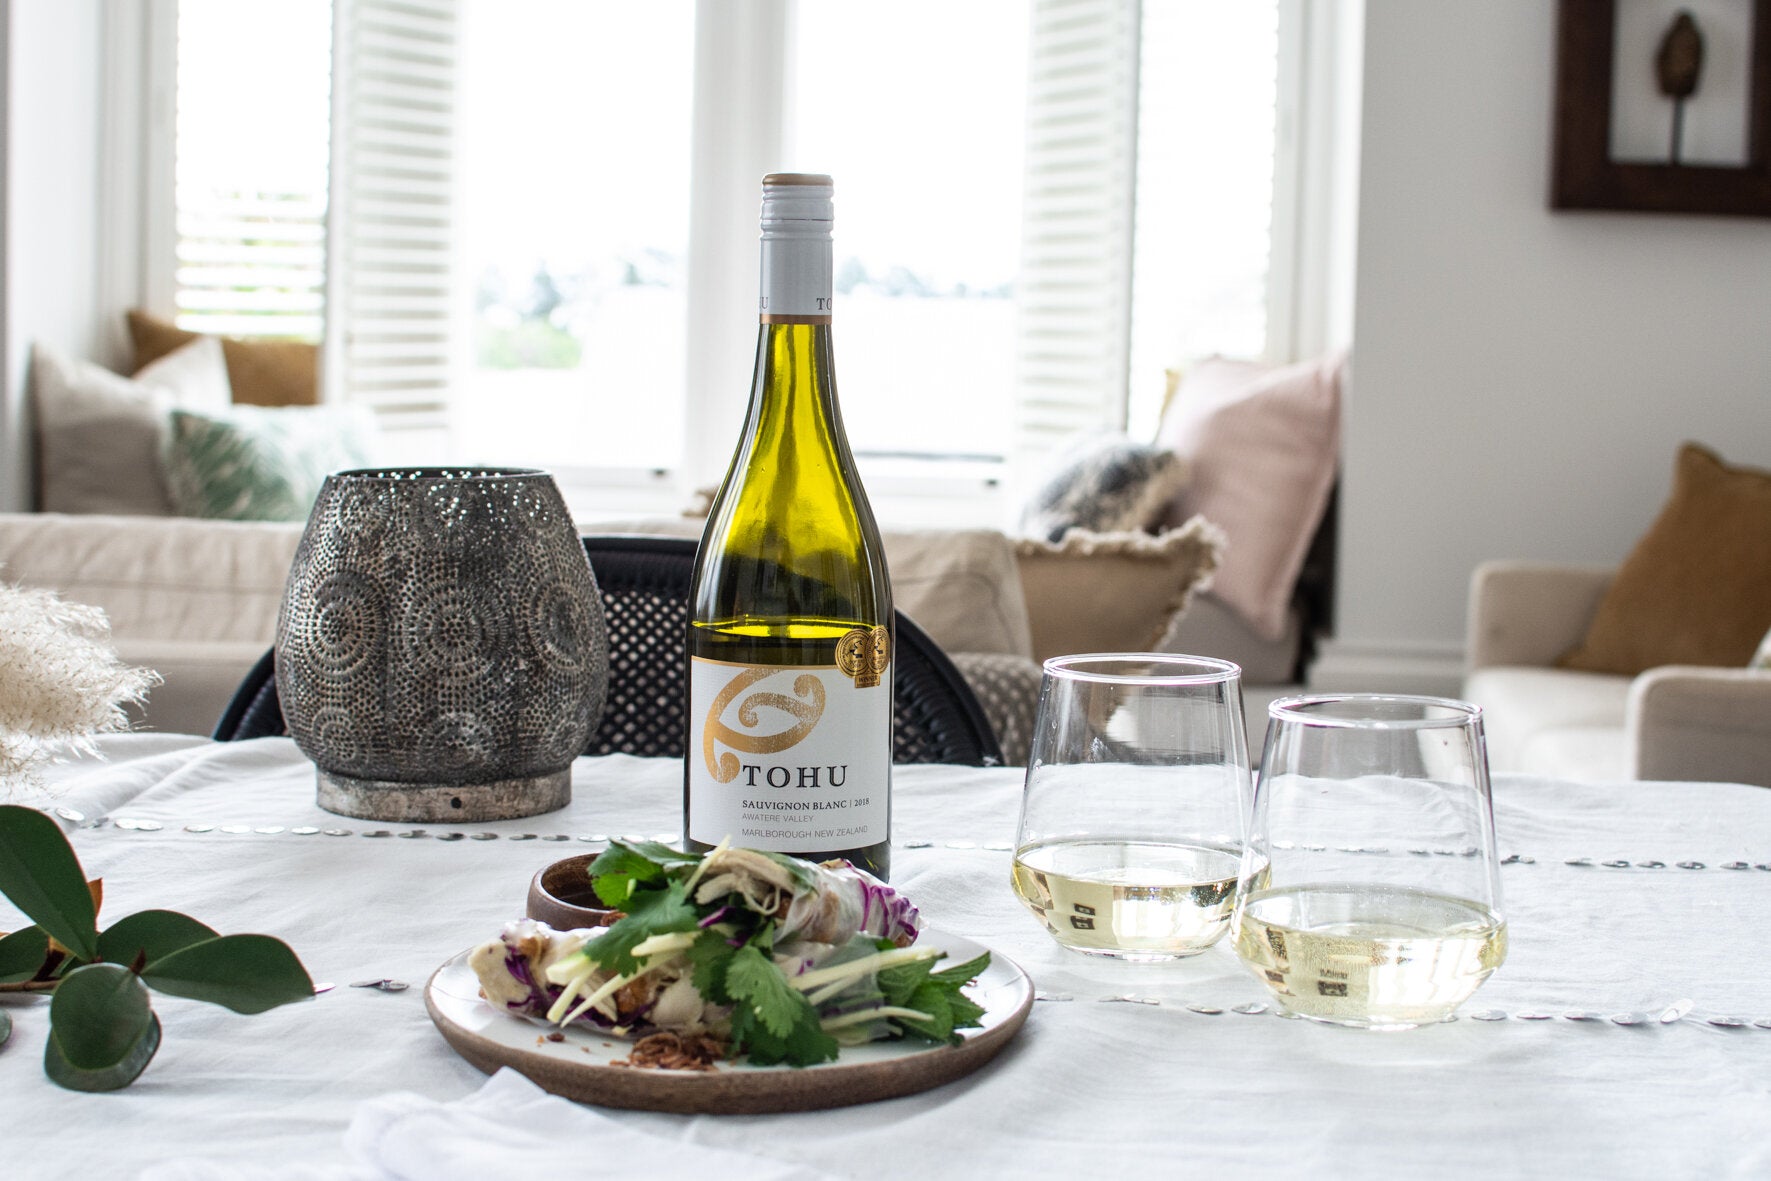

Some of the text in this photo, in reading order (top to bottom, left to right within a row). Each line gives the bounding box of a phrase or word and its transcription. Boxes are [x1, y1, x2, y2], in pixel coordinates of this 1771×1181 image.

[742, 765, 848, 788] TOHU
[742, 798, 870, 811] SAUVIGNON BLANC 2018
[742, 813, 814, 823] AWATERE VALLEY
[742, 825, 868, 839] MARLBOROUGH NEW ZEALAND
